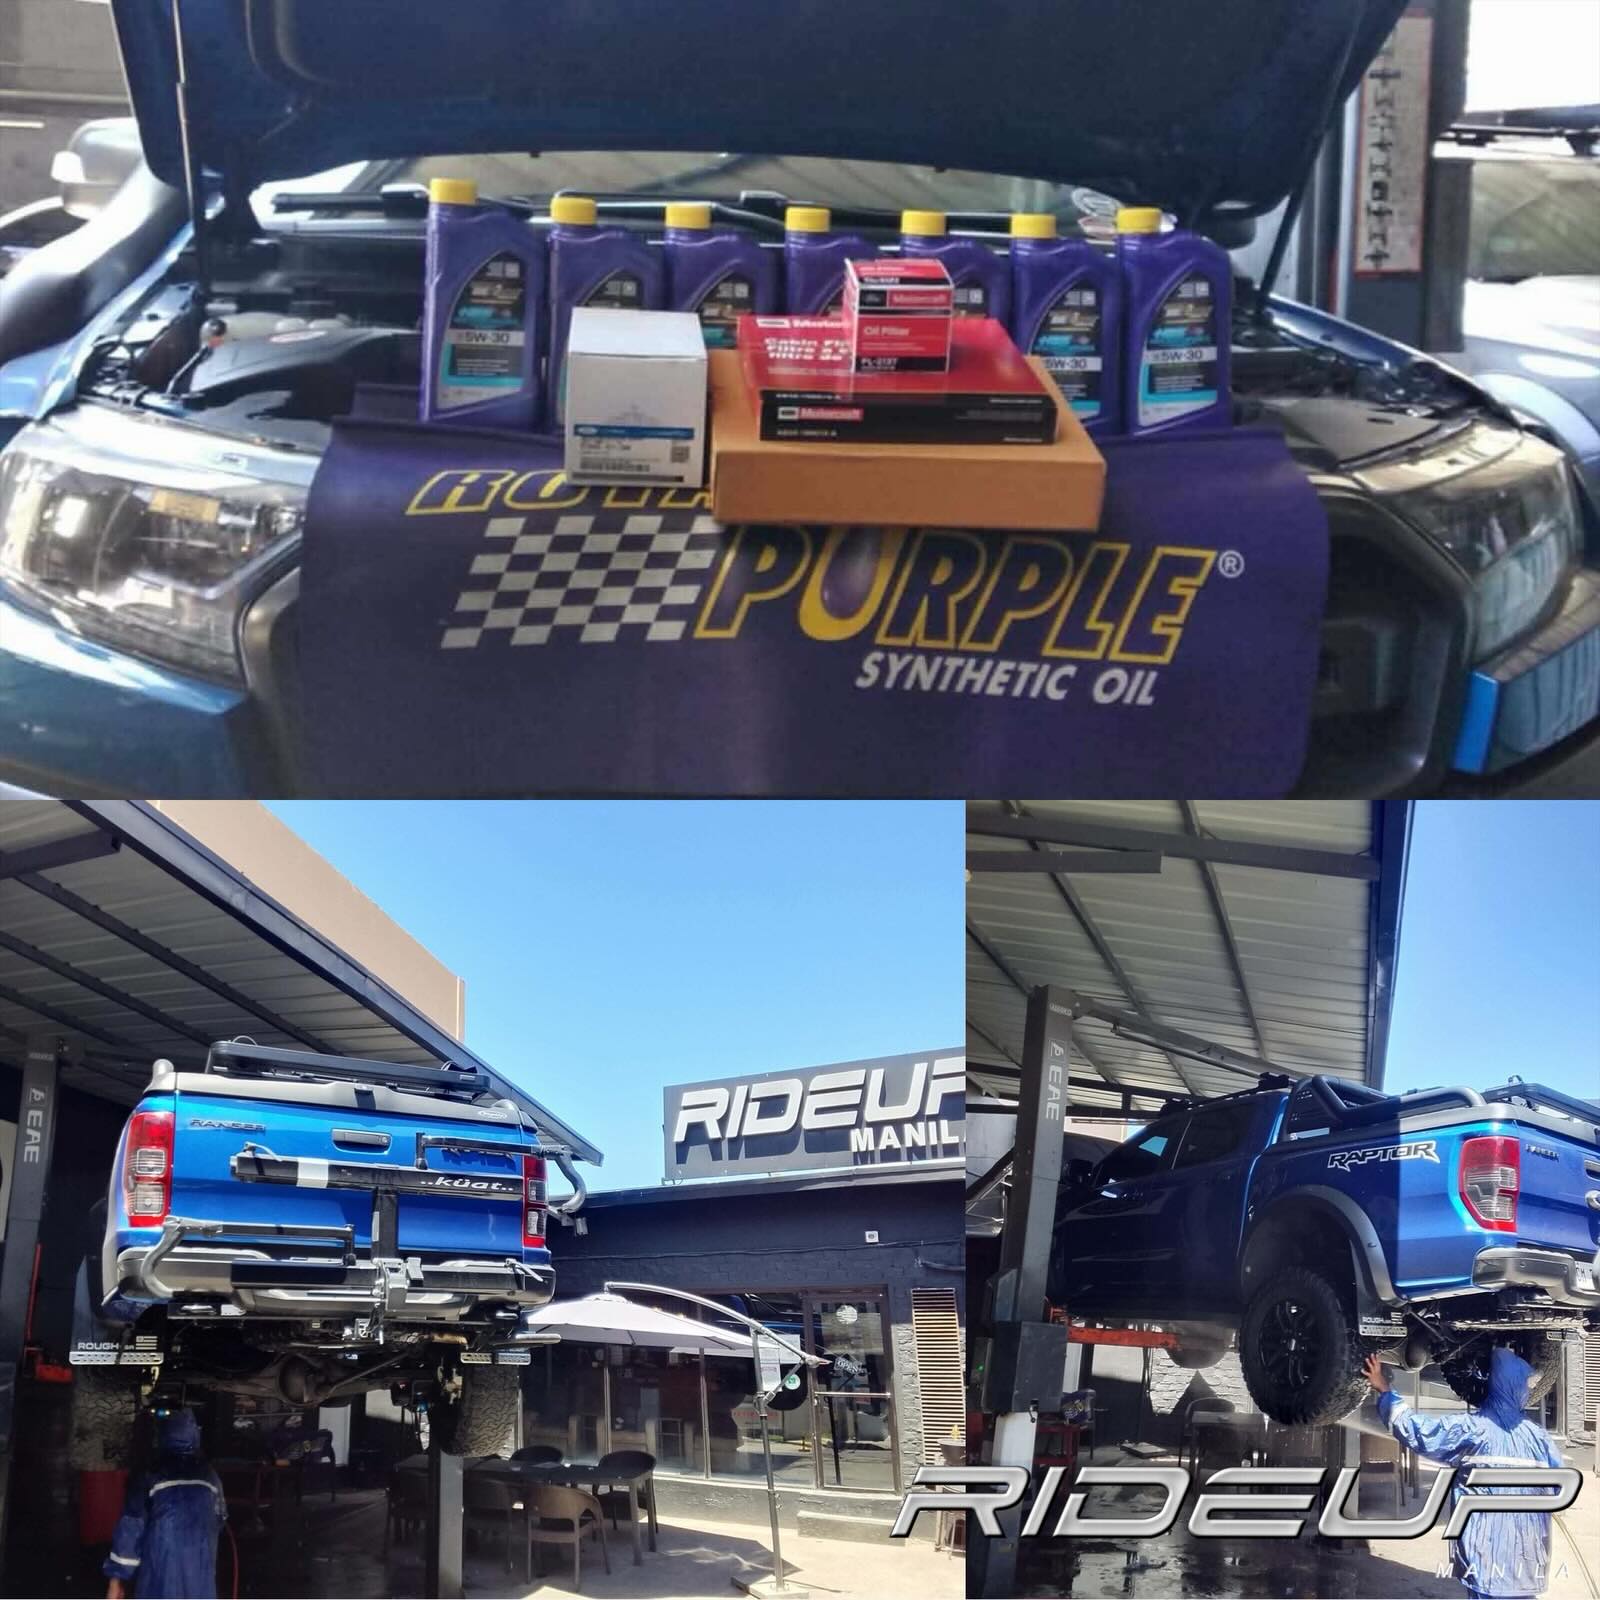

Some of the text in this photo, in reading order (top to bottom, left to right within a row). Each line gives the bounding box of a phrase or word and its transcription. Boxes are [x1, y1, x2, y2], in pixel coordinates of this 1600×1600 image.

[693, 524, 1219, 665] PURPLE
[856, 651, 1160, 706] SYNTHETIC OIL
[1046, 1065, 1062, 1121] EAE
[23, 1109, 44, 1164] EAE
[851, 1119, 966, 1153] MANIL
[1327, 1140, 1440, 1173] RAPTOR
[77, 1342, 120, 1351] ROUGH
